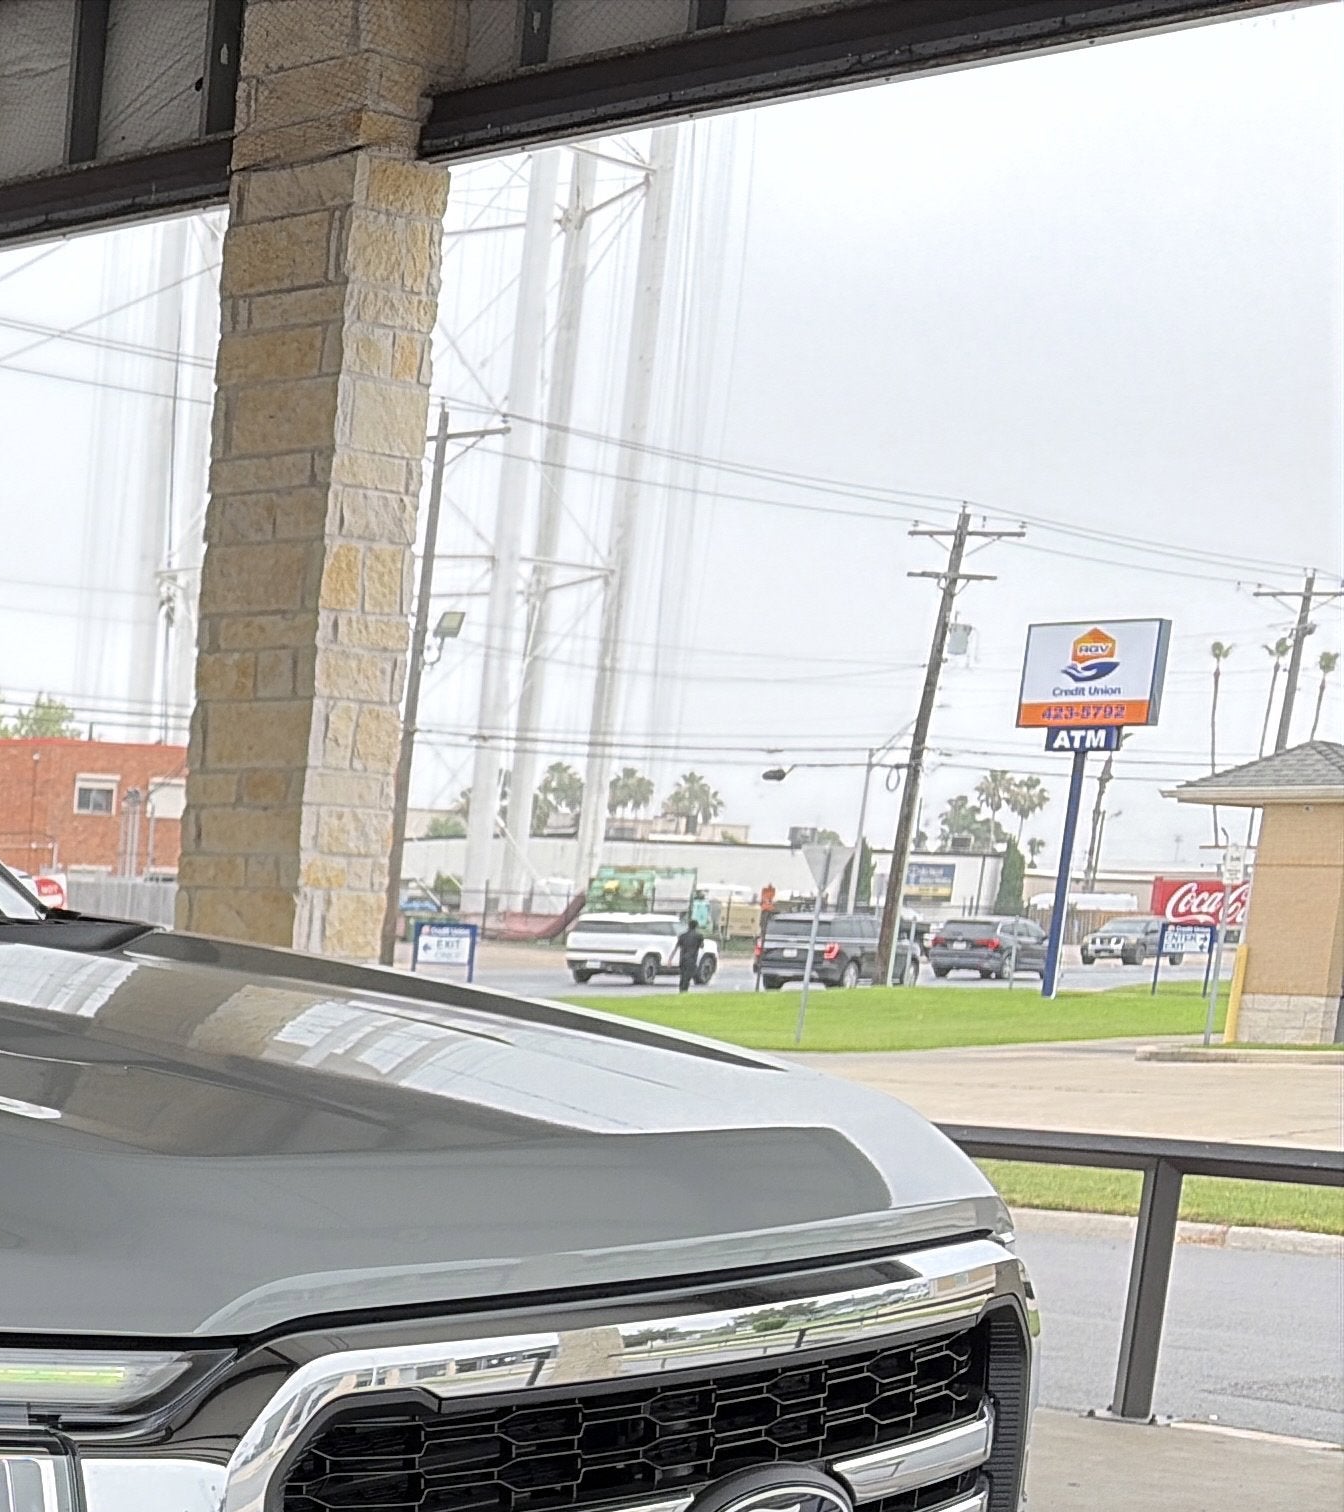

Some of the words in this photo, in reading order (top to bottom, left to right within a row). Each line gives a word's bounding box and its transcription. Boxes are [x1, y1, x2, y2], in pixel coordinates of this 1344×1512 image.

[1052, 686, 1086, 698] Credit
[1088, 685, 1122, 697] Union
[1053, 729, 1107, 748] ATM
